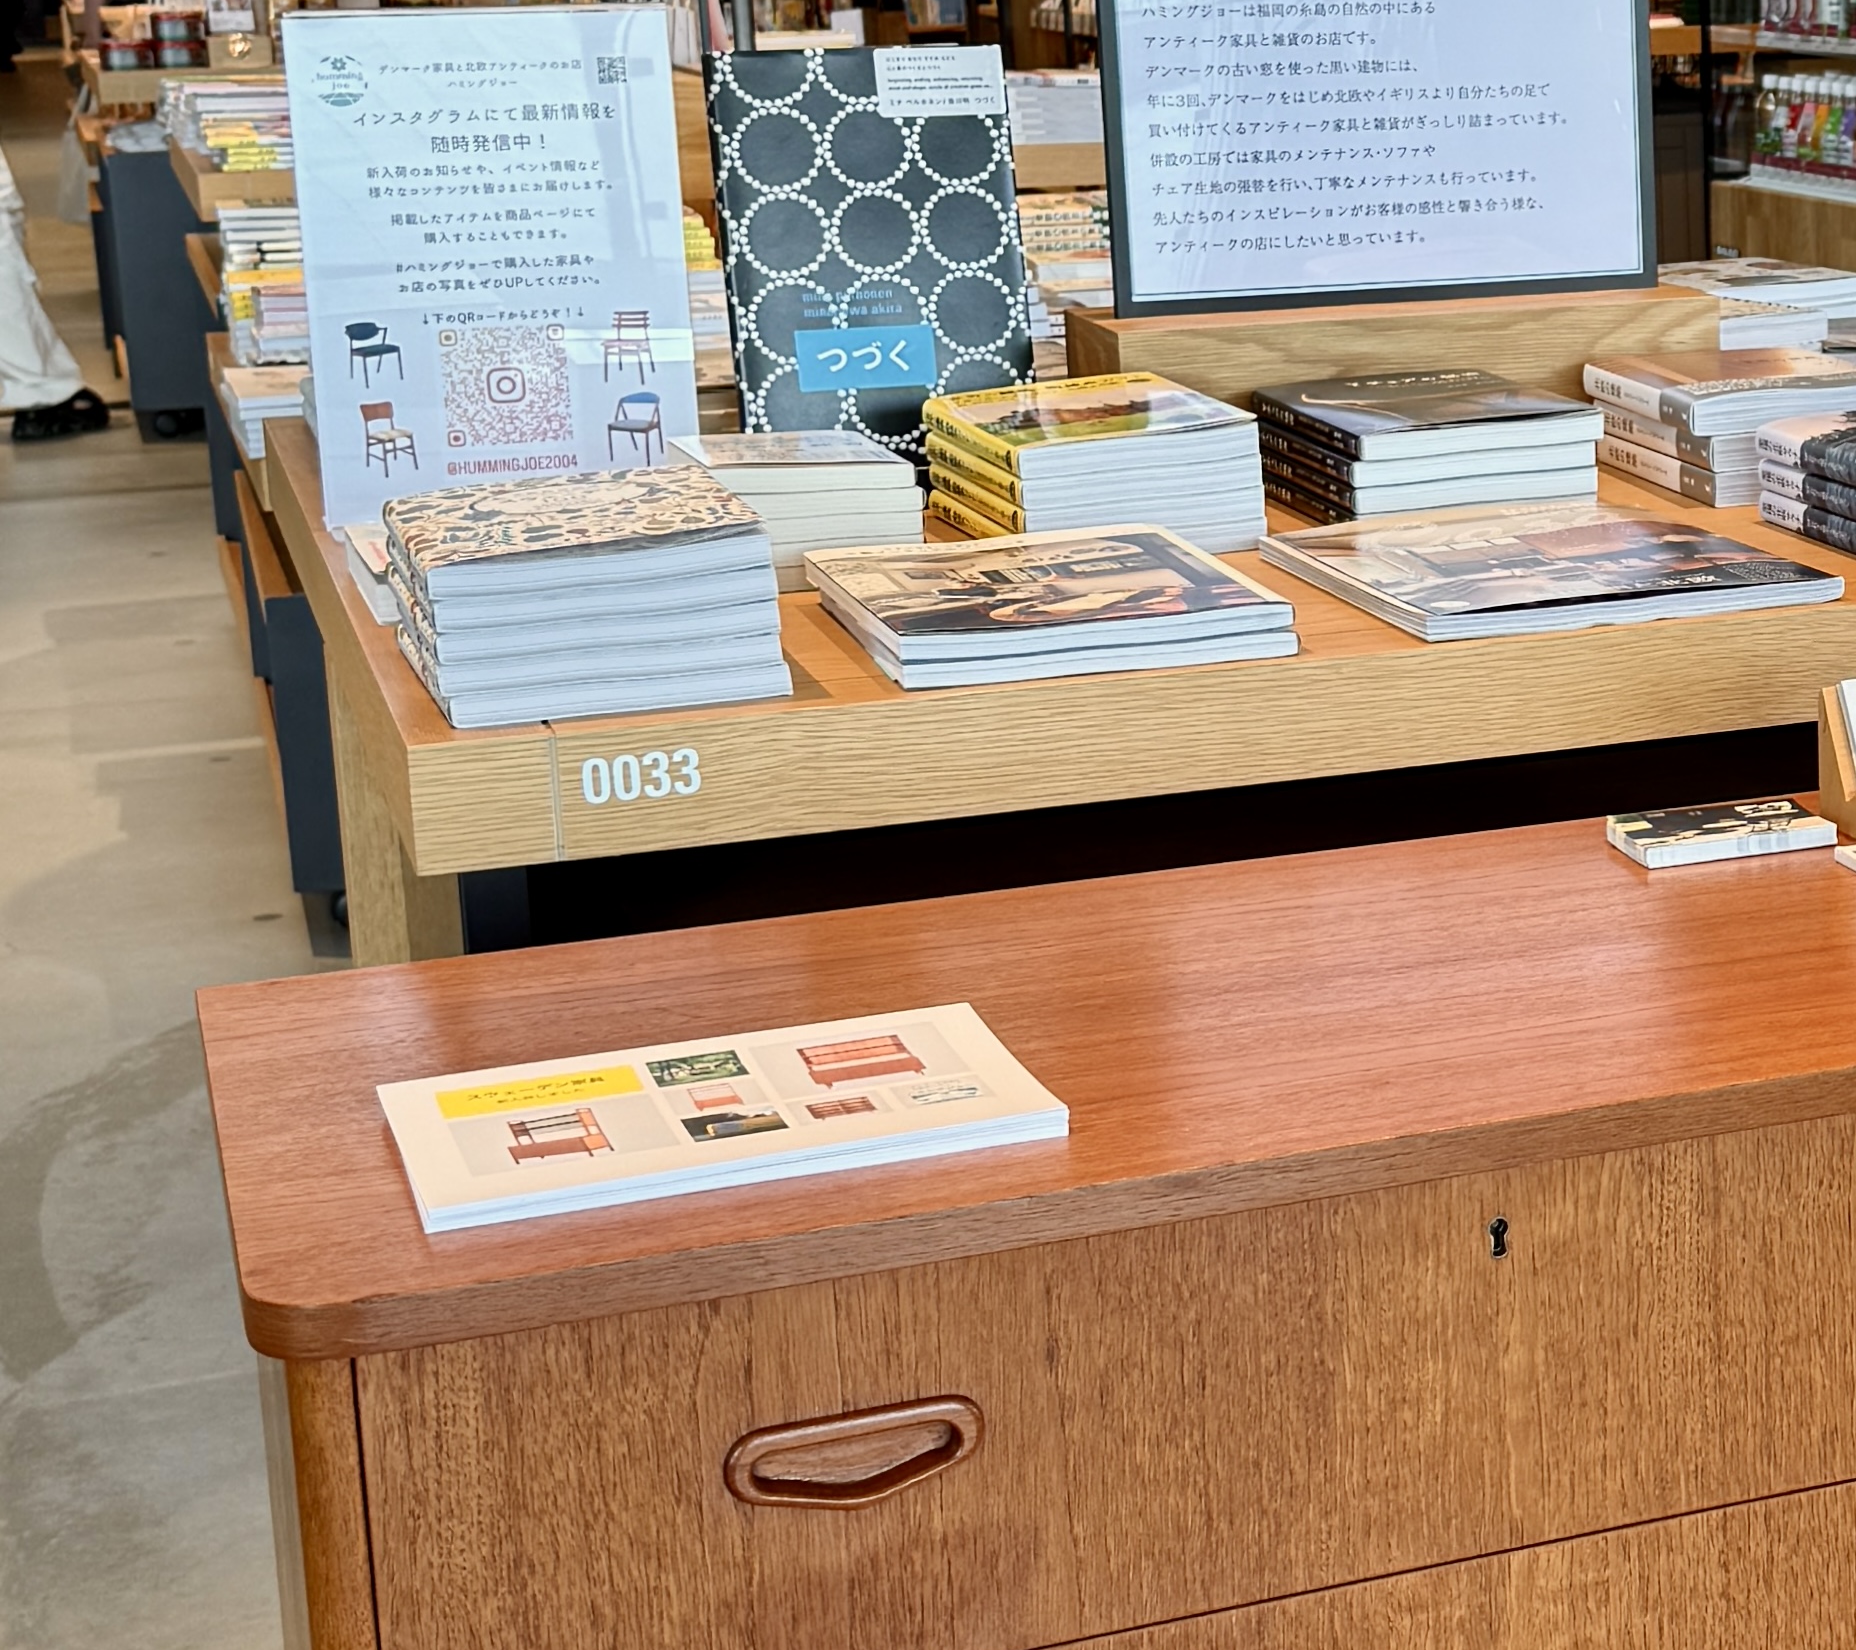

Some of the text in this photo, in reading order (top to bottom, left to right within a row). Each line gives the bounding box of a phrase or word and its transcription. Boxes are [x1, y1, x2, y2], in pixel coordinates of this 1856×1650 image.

[1142, 1, 1436, 18] ハミングジョーは福岡の糸島の自然の中にある
[1144, 31, 1377, 49] アンティーク家具と雑貨のお店です。
[378, 57, 583, 75] デンマーク家具と北欧アンティークのお店
[1146, 59, 1419, 79] デンマークの古い窓を使った黒い建物には、
[447, 76, 519, 88] ハミングジョー
[1147, 83, 1551, 109] 年に3回、デンマークをはじめ北欧やイギリスより自分たちの足で
[353, 102, 616, 127] インスタグラムにて最新情報を
[1149, 111, 1568, 138] 買い付けてくるアンティーク家具と雑貨がぎっしり詰まっています。
[431, 132, 547, 154] 随時発信中！
[366, 159, 600, 180] 新入荷のお知らせや、イベント情報など
[368, 178, 614, 199] 様々なコンテンツを皆さまにお届けします。
[1152, 168, 1537, 197] チェア生地の張替を行い、丁寧なメンテナンスも行っています。
[390, 206, 596, 227] 掲載したアイテムを商品ページにて
[423, 229, 568, 245] 購入することもできます。
[1155, 230, 1426, 254] アンティークの店にしたいと思っています。
[396, 253, 595, 275] #ハミングジョーで購入した家具や
[398, 273, 600, 293] お店の写真をぜひUPしてください。
[816, 339, 910, 373] つづく
[447, 452, 579, 477] @HUMMINGJOE2004
[581, 747, 702, 805] 0033
